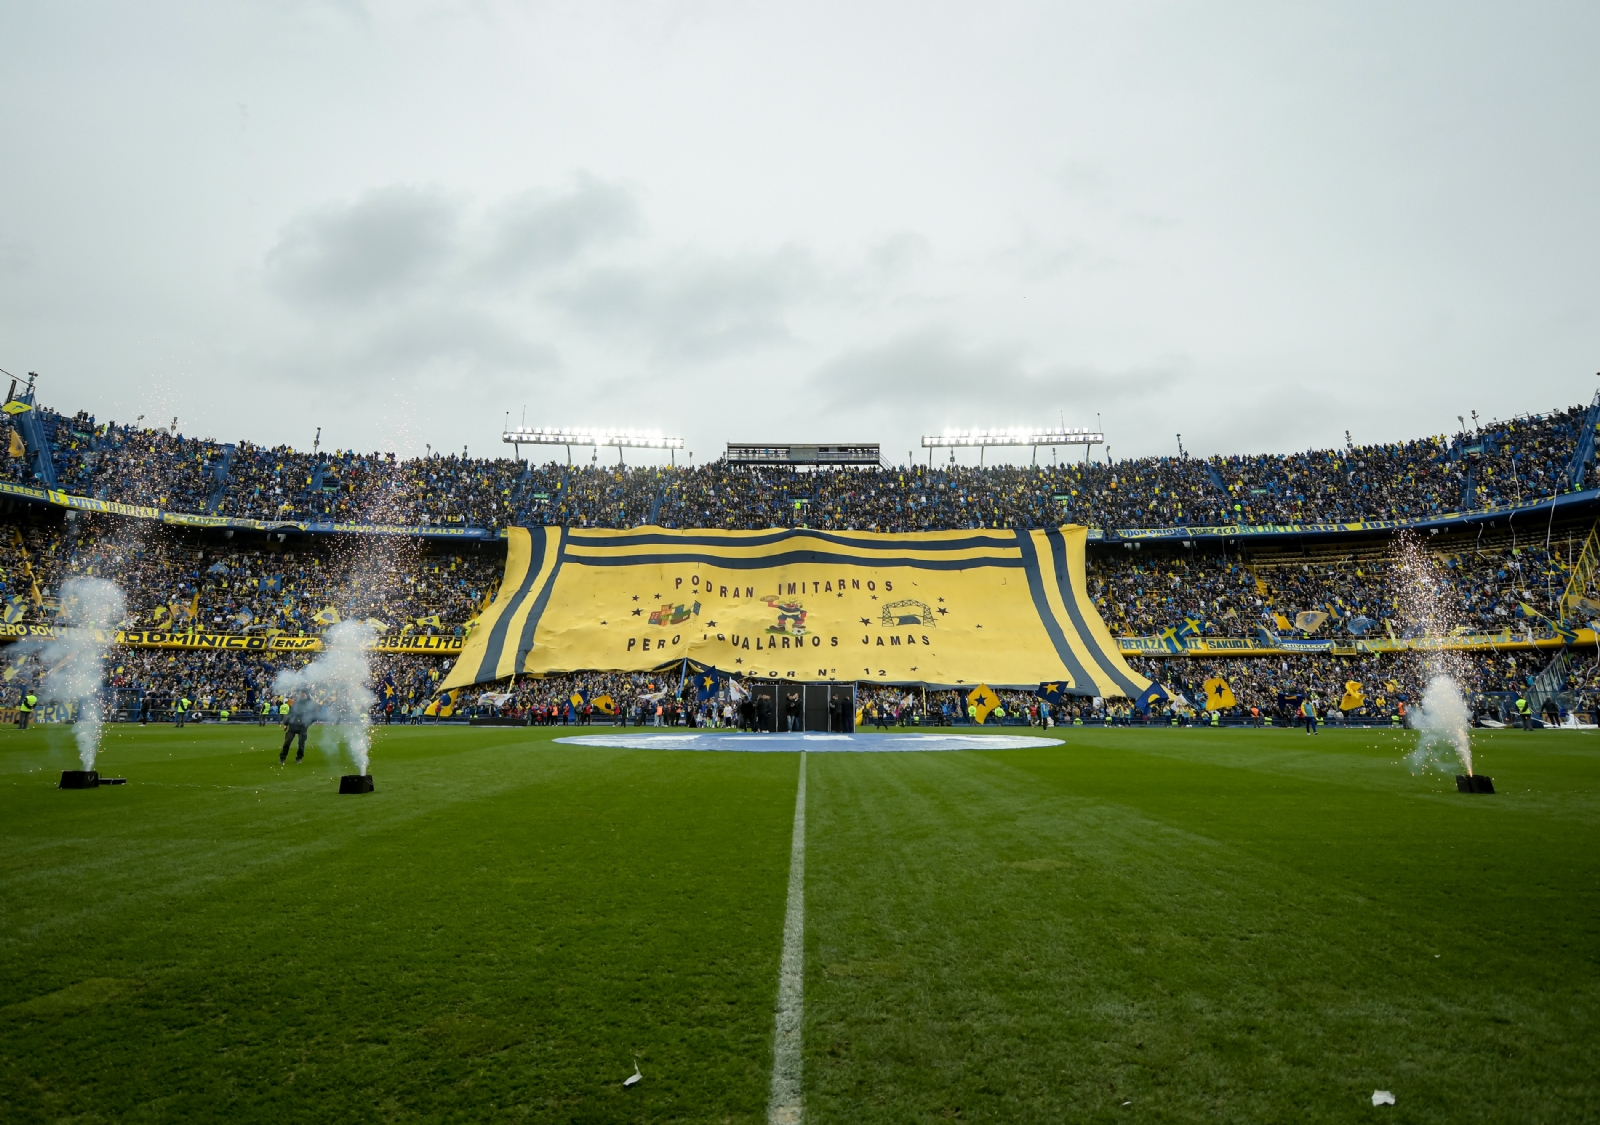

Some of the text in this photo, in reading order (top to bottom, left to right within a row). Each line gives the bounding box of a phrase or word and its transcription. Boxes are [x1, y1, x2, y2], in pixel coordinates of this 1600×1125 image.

[675, 575, 893, 599] PODRAN IMITARNOS
[30, 626, 54, 637] SOY
[124, 631, 265, 649] DOMINICO
[366, 635, 463, 649] ABALLITO
[626, 634, 681, 651] PERO
[861, 634, 931, 647] JAMAS
[863, 667, 887, 677] 12
